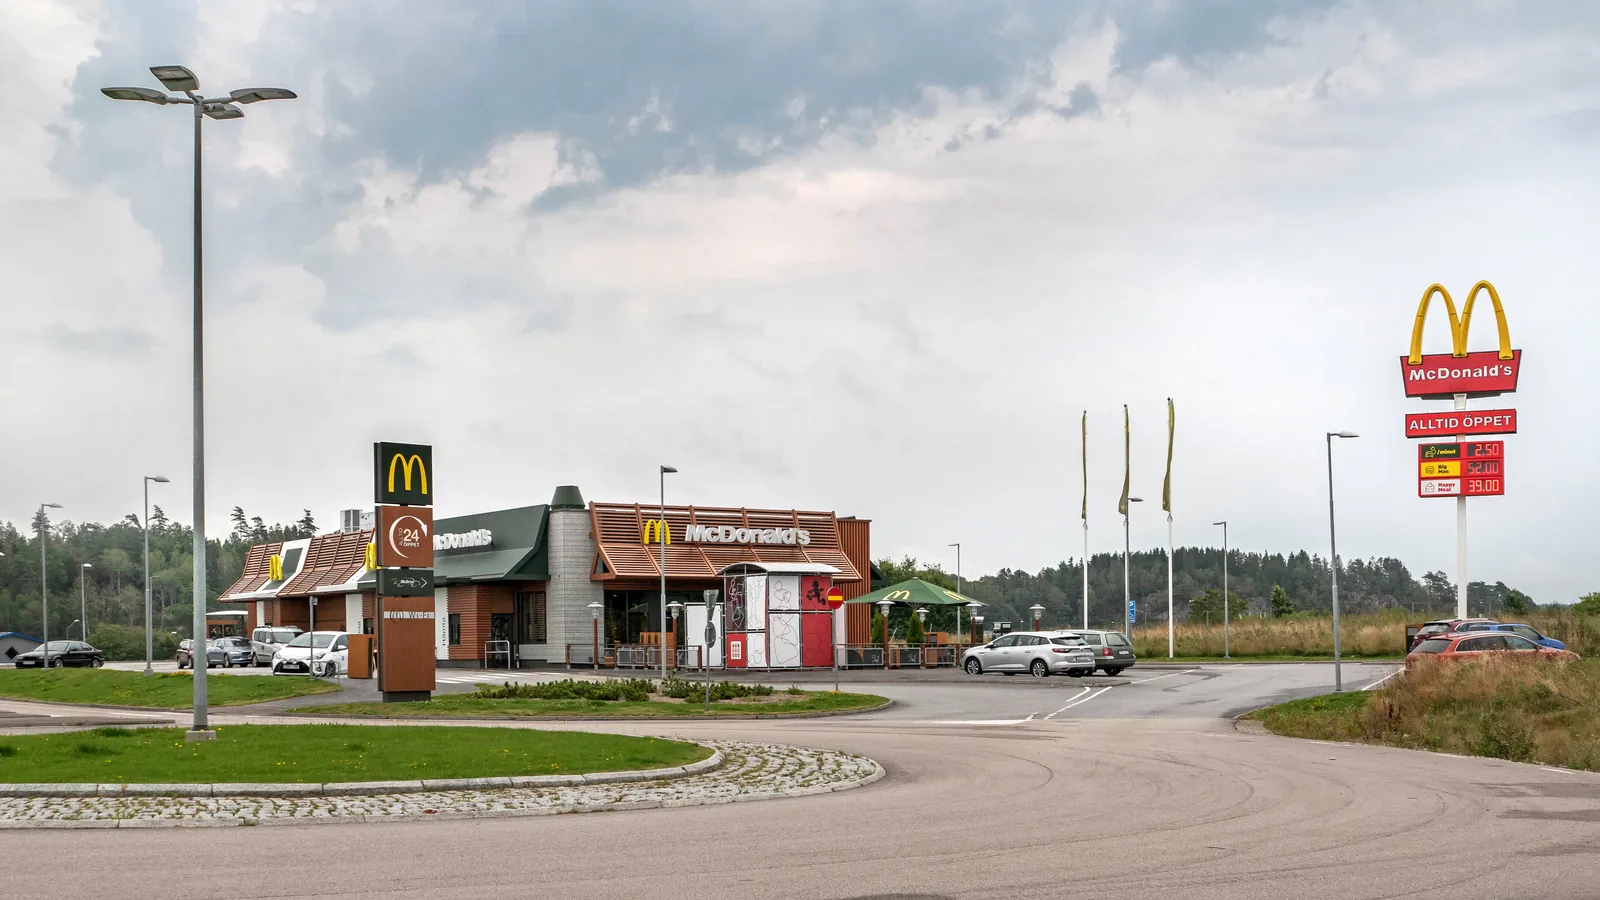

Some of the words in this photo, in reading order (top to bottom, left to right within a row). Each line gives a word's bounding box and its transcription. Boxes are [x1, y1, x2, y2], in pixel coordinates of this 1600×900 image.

[1409, 365, 1512, 381] McDonald's
[1409, 418, 1458, 430] ALLTID
[1463, 415, 1511, 427] ÖPPET
[1475, 444, 1499, 456] 2.50
[1469, 480, 1499, 492] 39.00
[403, 529, 420, 542] 24
